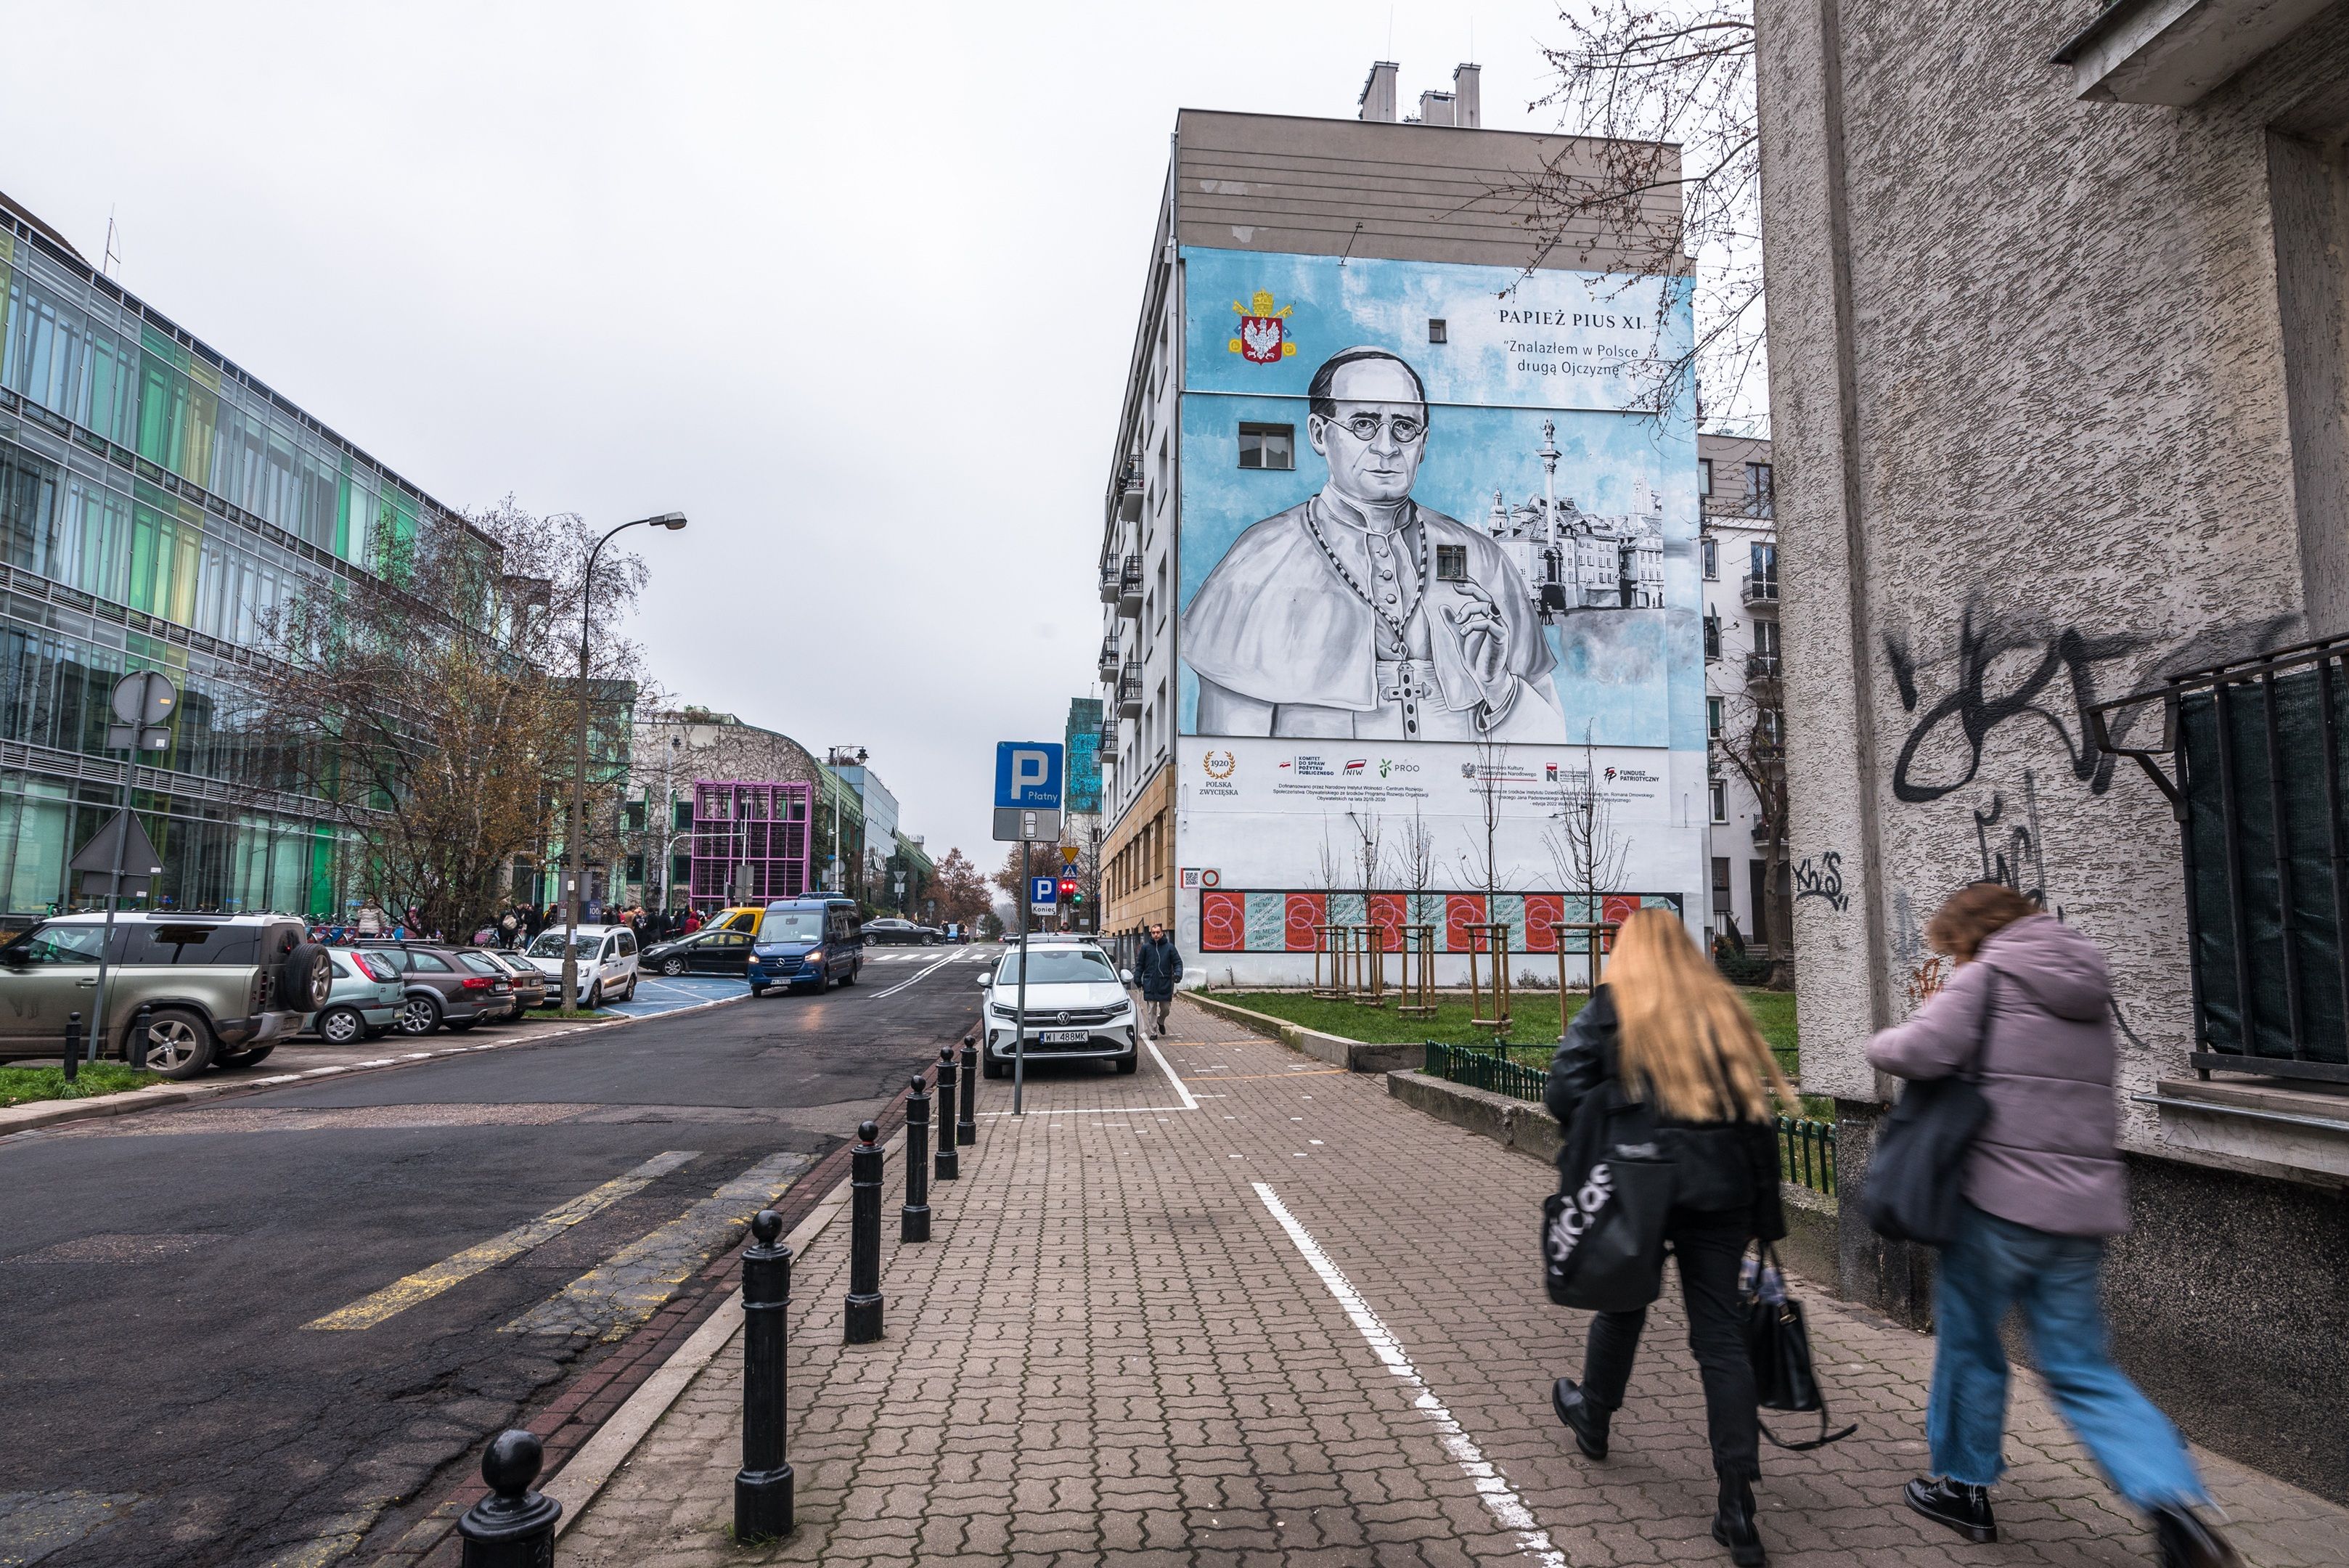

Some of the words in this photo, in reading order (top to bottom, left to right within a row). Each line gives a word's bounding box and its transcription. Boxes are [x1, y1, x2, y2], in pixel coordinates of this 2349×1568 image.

[1499, 309, 1566, 326] PAPIEŻ
[1573, 314, 1616, 329] PIUS
[1582, 346, 1593, 356] w
[1598, 344, 1638, 358] Polsce
[1517, 359, 1557, 376] drugą
[1210, 759, 1229, 768] 1920
[1011, 750, 1048, 799] P
[1028, 791, 1058, 803] Płatny
[1037, 880, 1052, 900] P
[1046, 1033, 1055, 1042] WI
[1060, 1032, 1086, 1041] 488MK
